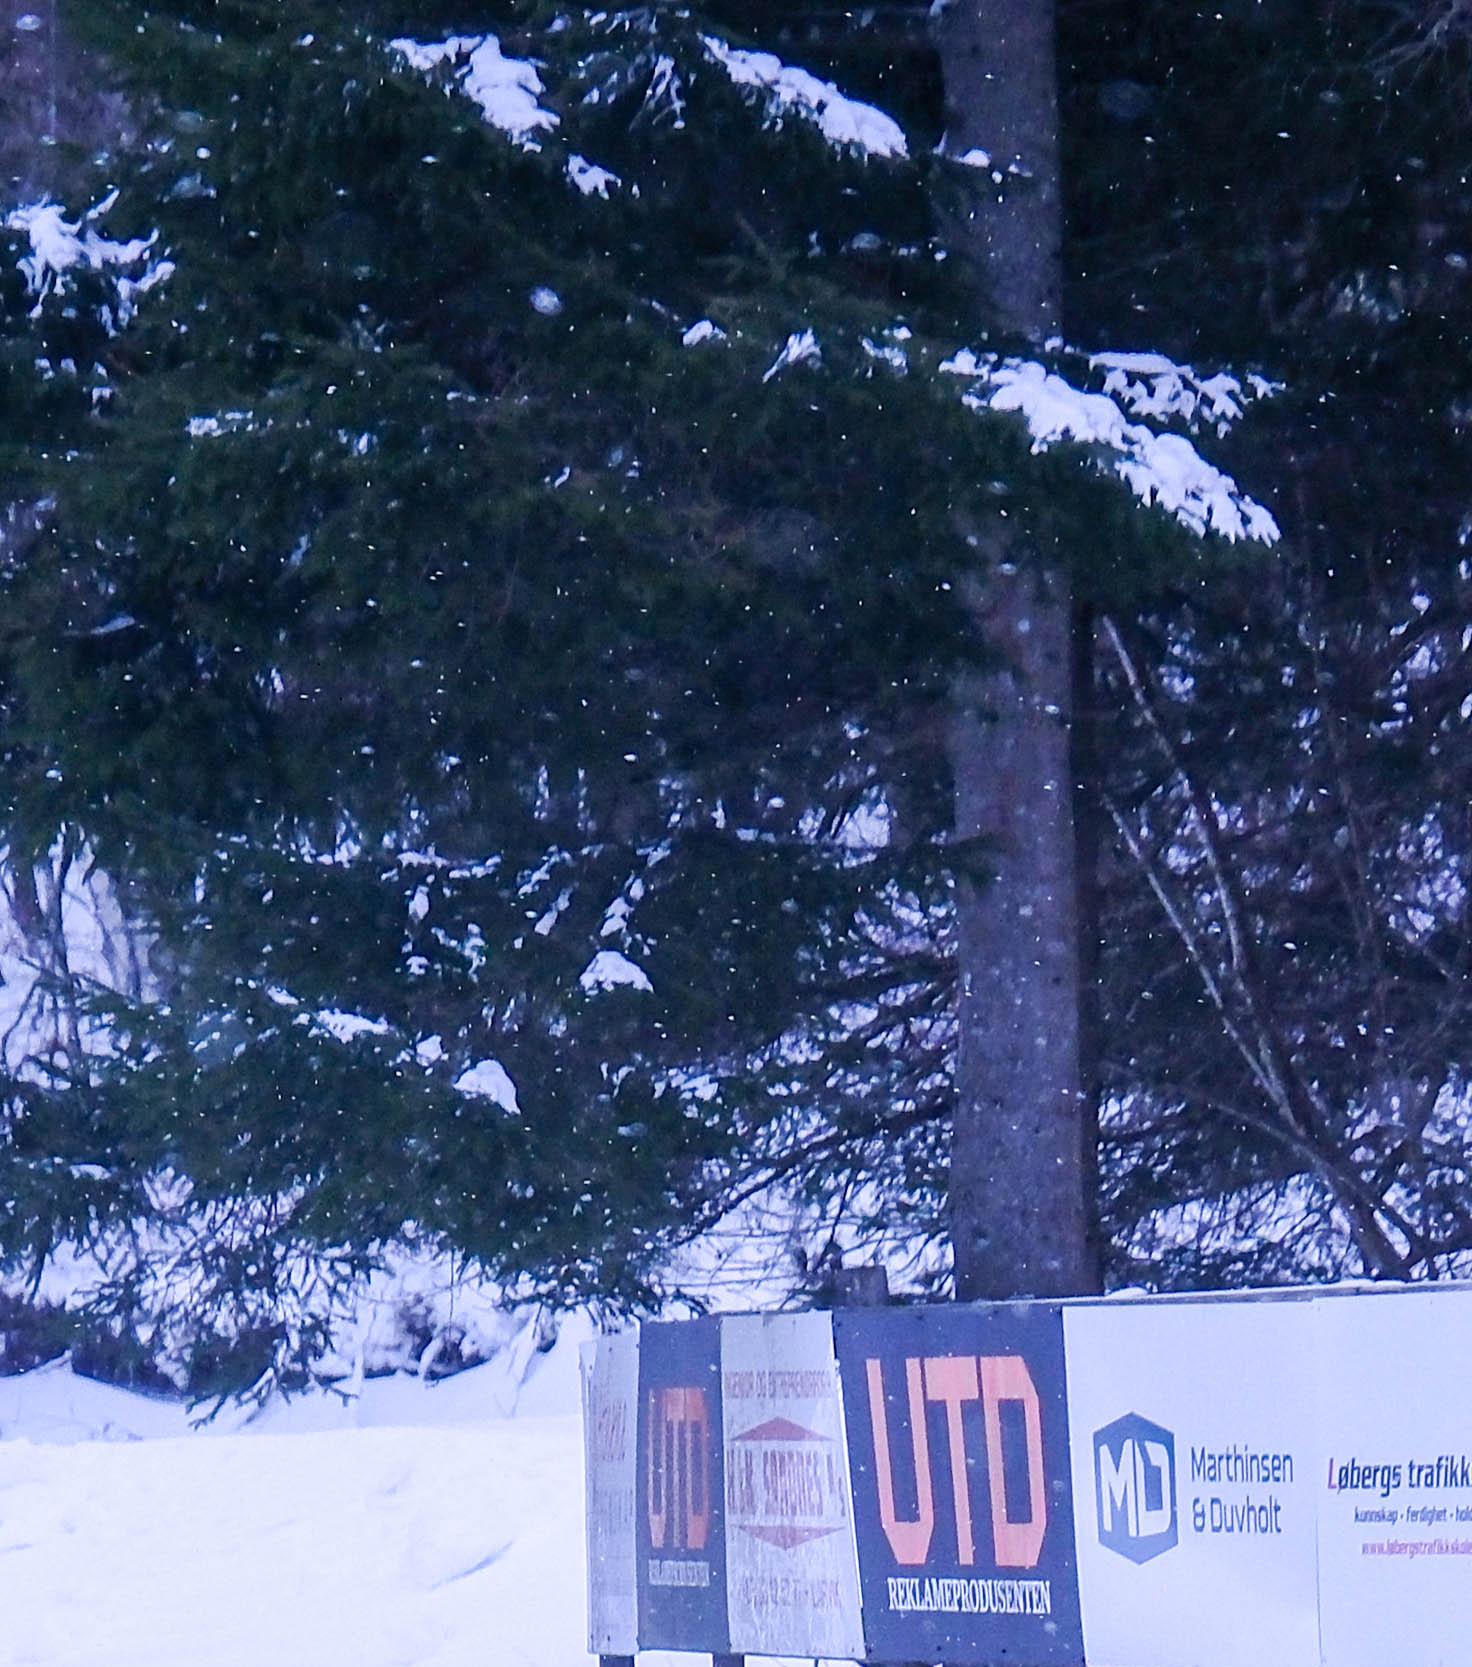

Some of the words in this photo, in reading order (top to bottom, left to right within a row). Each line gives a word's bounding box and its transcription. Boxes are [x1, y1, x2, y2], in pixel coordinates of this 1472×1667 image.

[866, 1356, 1047, 1567] UTD
[1191, 1444, 1294, 1483] Marthinsen
[1327, 1457, 1402, 1498] Løbergs
[1099, 1439, 1172, 1537] MD
[1193, 1497, 1205, 1533] &
[1210, 1495, 1282, 1534] Duvholt
[1354, 1505, 1398, 1526] kunnskap
[1406, 1505, 1447, 1526] ferdighet
[887, 1576, 1052, 1615] REKLAMEPRODUSENTEN
